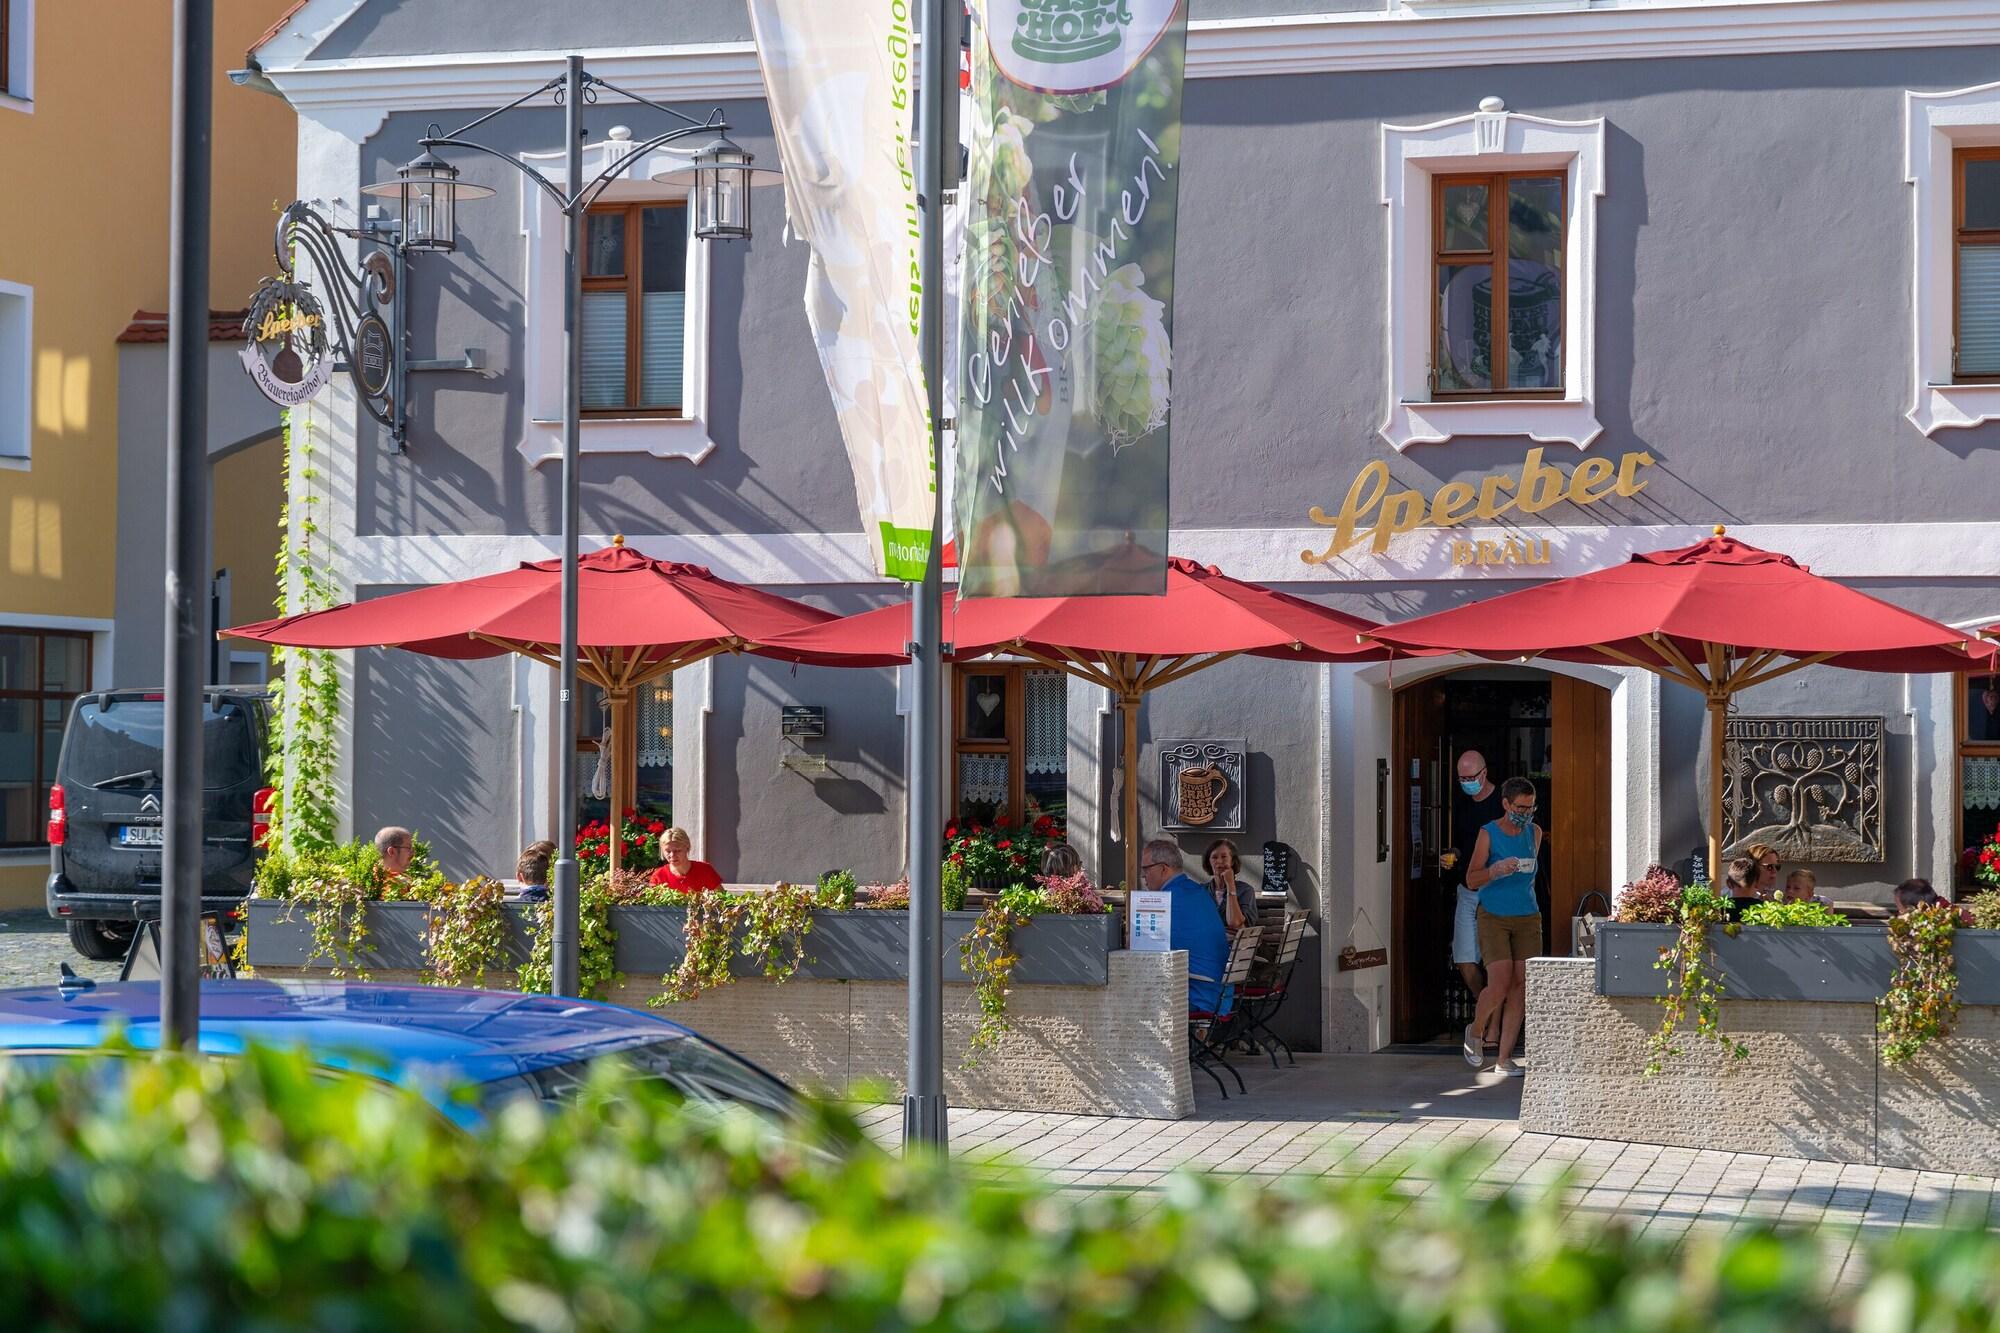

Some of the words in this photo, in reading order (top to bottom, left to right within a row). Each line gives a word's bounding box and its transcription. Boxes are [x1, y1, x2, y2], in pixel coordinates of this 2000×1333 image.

[256, 310, 321, 342] Sperber
[1300, 447, 1656, 565] Sperber
[1453, 532, 1551, 565] BRÄU
[130, 828, 151, 841] SUL
